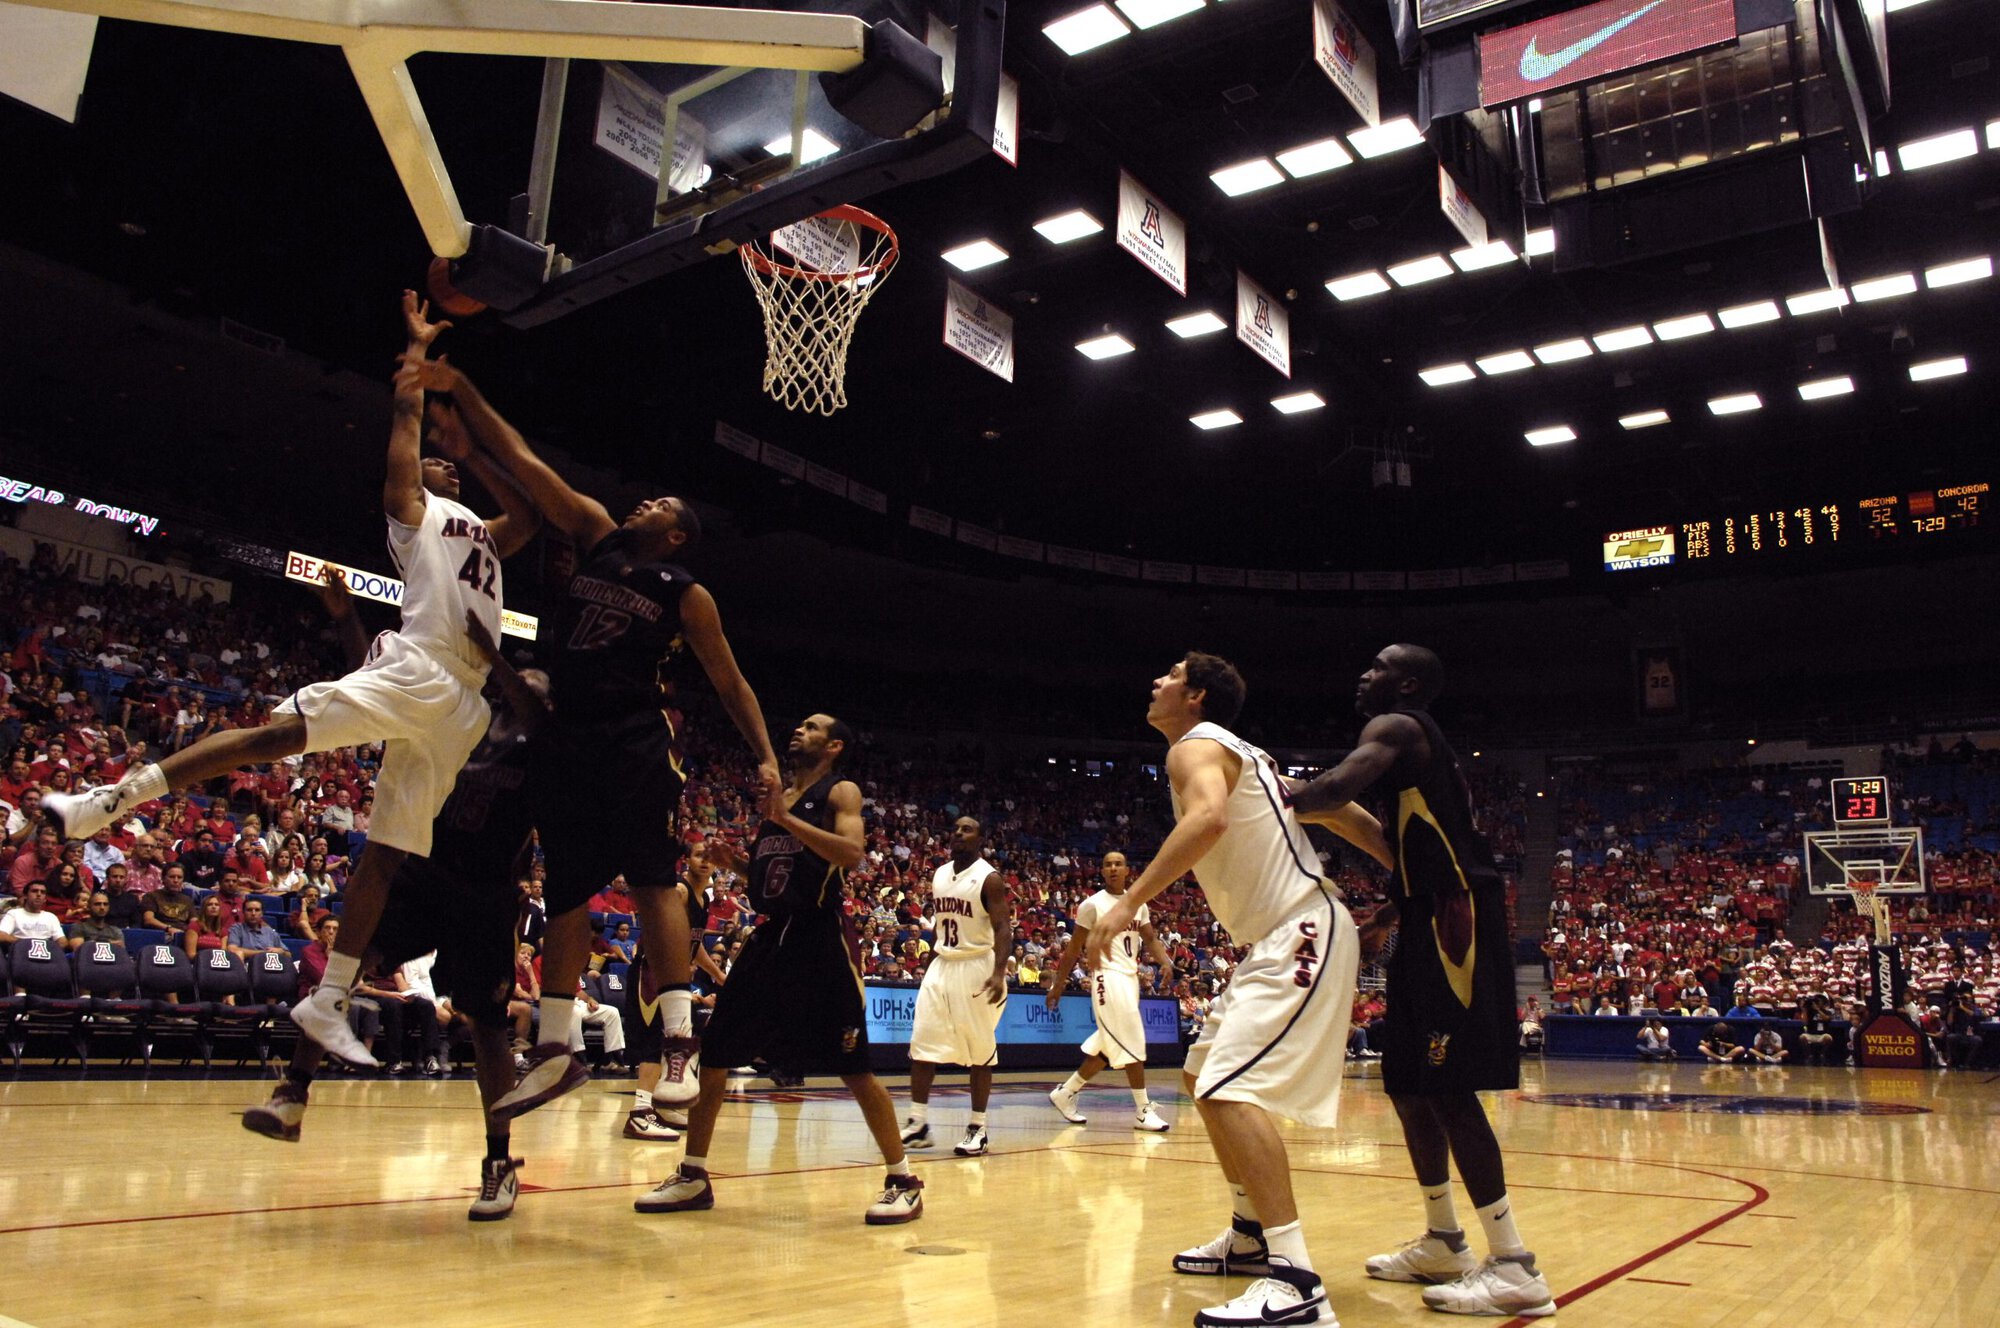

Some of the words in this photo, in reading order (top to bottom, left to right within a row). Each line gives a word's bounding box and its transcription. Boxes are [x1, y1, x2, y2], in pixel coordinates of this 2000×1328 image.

[1141, 199, 1164, 249] A
[1255, 294, 1273, 338] A
[1938, 483, 1989, 498] CONCORDIA
[1859, 495, 1898, 509] ARIZONA
[1957, 496, 1977, 511] 42
[1683, 521, 1709, 533] PLYR
[1725, 518, 1733, 527] 0
[1750, 514, 1759, 524] 5
[1769, 511, 1785, 522] 13
[1794, 508, 1811, 519] 42
[1820, 504, 1838, 515] 44
[1872, 508, 1891, 523] 52
[1912, 516, 1946, 533] 7:29
[1609, 527, 1668, 542] O'RIELLY
[1687, 539, 1709, 550] RBS
[1751, 532, 1760, 542] 5
[1804, 526, 1813, 536] 3
[1830, 522, 1840, 532] 3
[1688, 530, 1708, 541] PTS
[1803, 518, 1812, 527] 2
[1830, 514, 1839, 523] 0
[1726, 544, 1735, 554] 0
[1752, 541, 1761, 550] 0
[1778, 538, 1787, 547] 0
[1804, 535, 1813, 544] 0
[459, 547, 496, 601] 42
[1611, 556, 1670, 571] WATSON
[351, 572, 403, 602] DOW
[569, 575, 663, 623] CONCORDIA
[512, 618, 537, 631] TOYOTA
[568, 603, 633, 649] 12
[1650, 675, 1670, 689] 32
[1847, 780, 1883, 795] 7:29
[1846, 797, 1878, 819] 23
[763, 856, 794, 899] 6
[942, 918, 958, 947] 13
[28, 939, 51, 961] A
[93, 942, 116, 963] A
[154, 945, 175, 965] A
[1124, 935, 1132, 958] 0
[1294, 921, 1319, 988] CATS
[210, 949, 231, 969] A
[264, 953, 284, 971] A
[1096, 974, 1106, 1006] CATS
[1878, 950, 1895, 1011] ARIZONA
[1865, 1034, 1916, 1045] WELLS
[1868, 1045, 1916, 1056] FARGO
